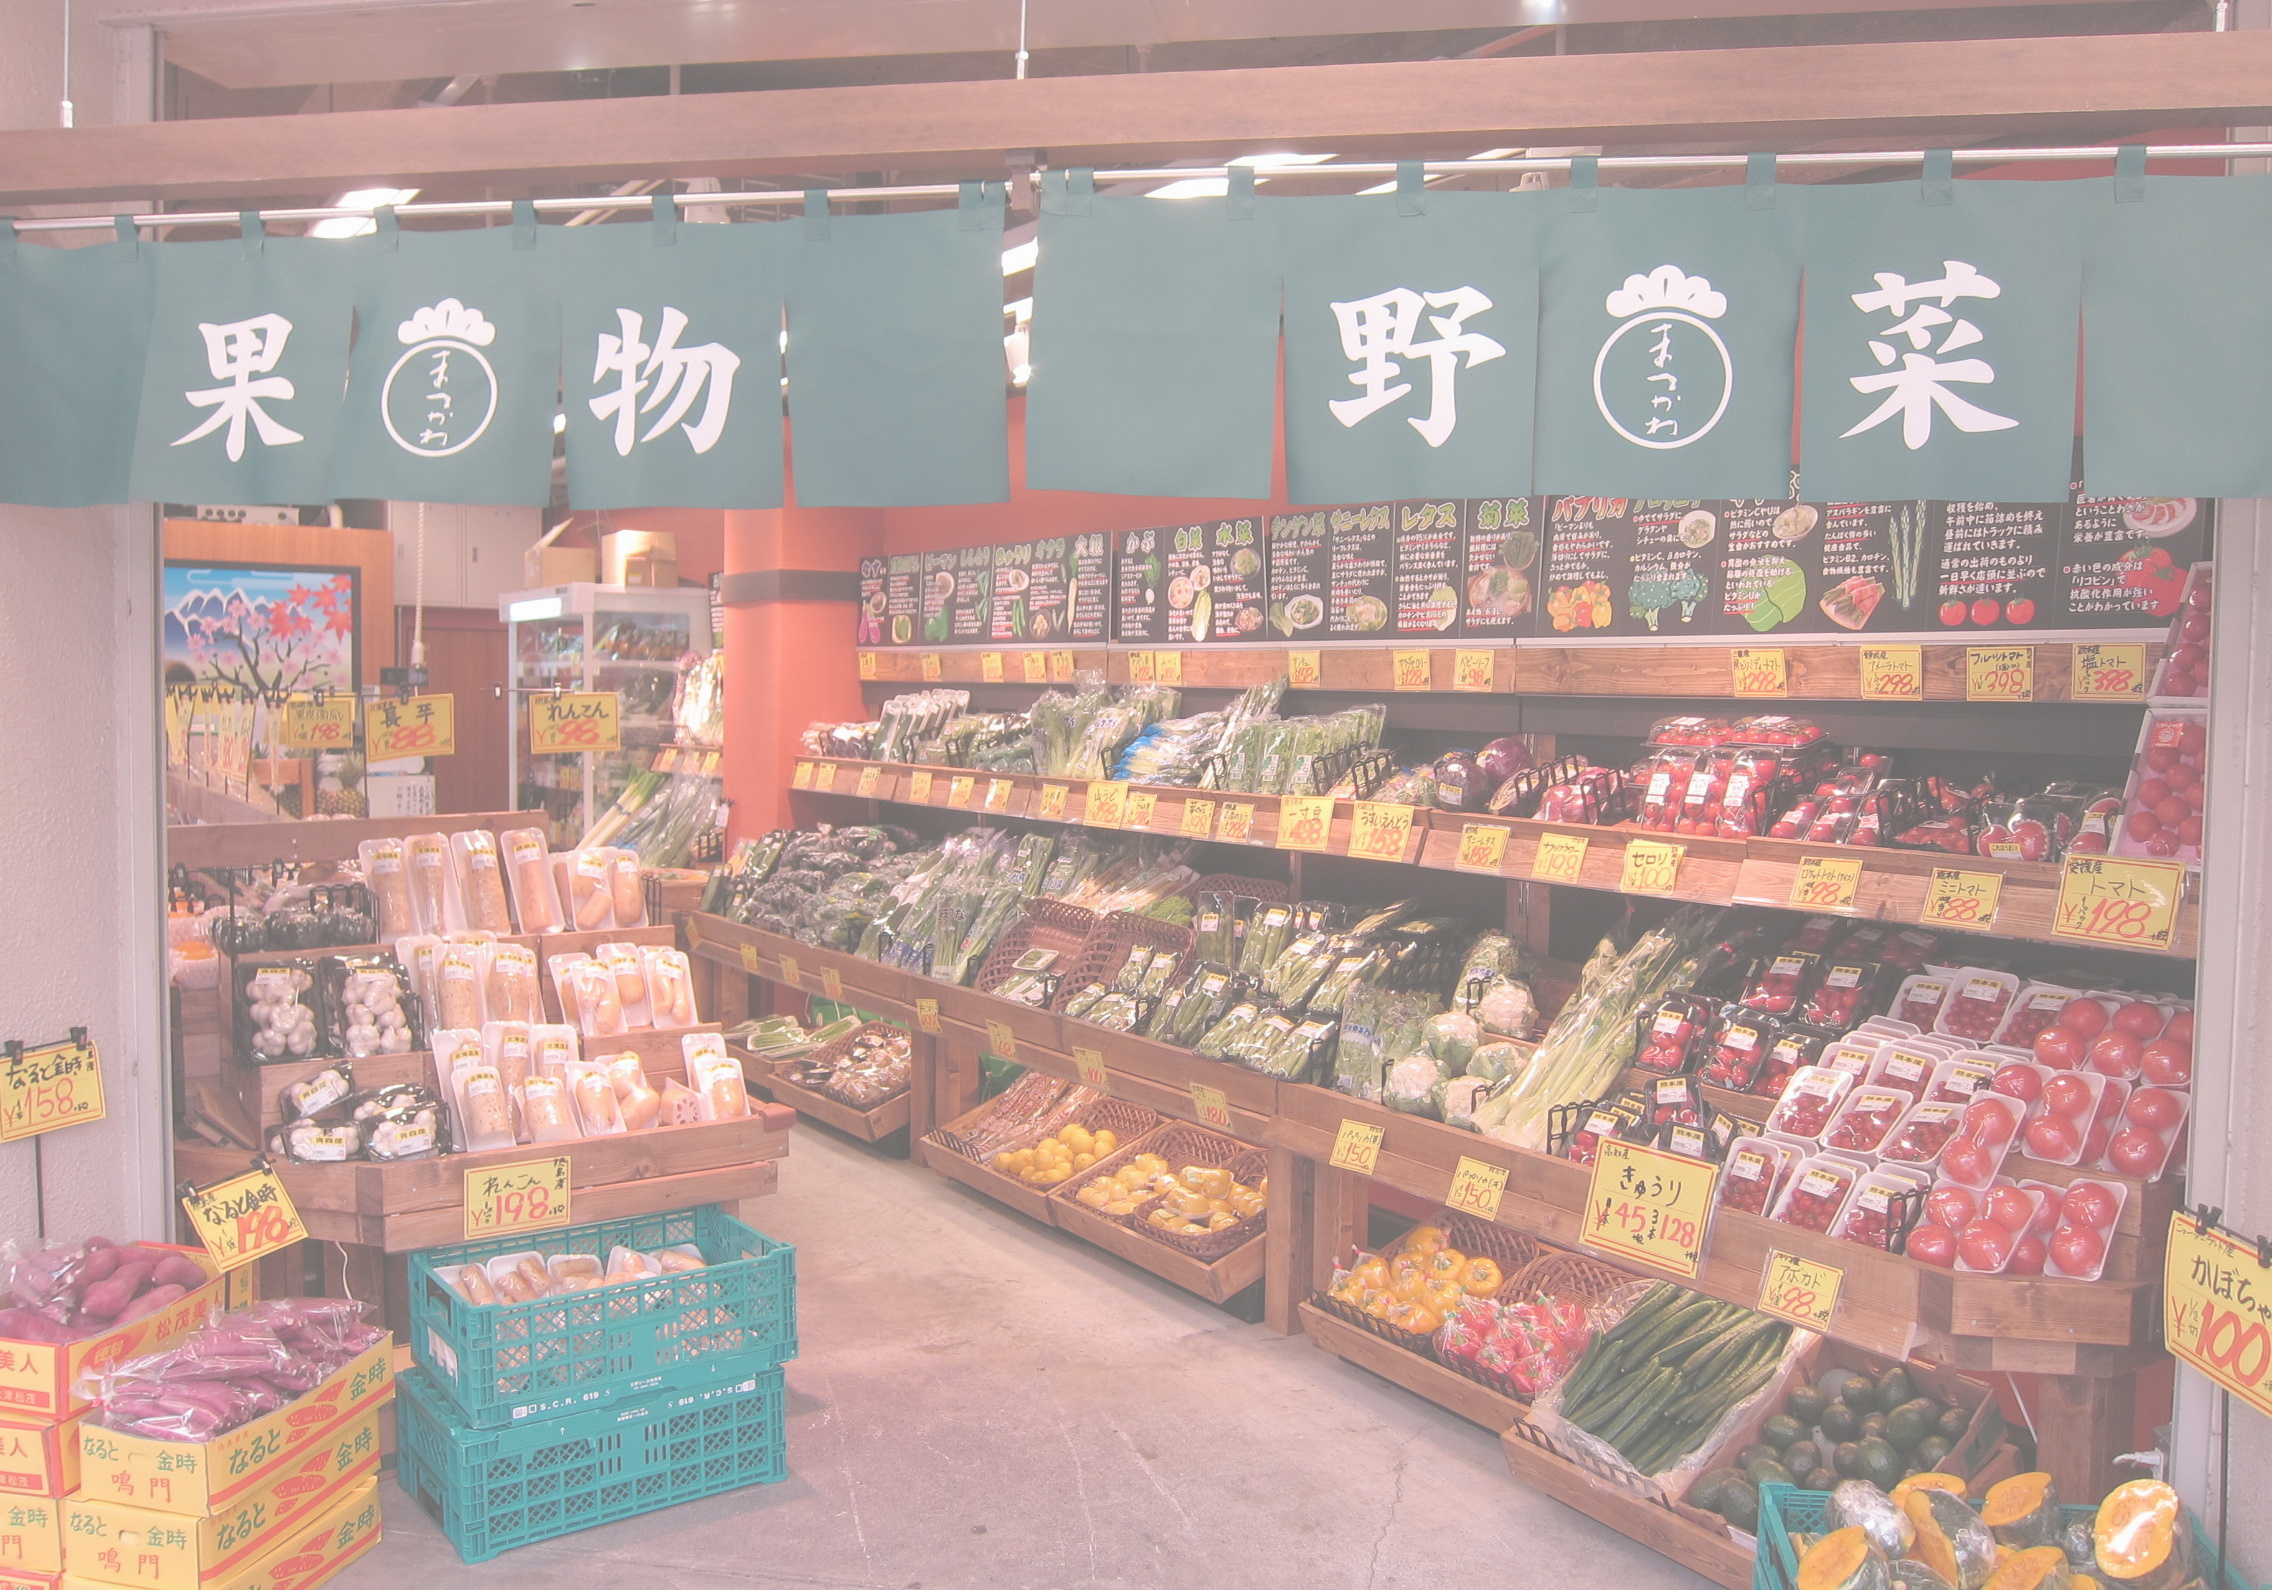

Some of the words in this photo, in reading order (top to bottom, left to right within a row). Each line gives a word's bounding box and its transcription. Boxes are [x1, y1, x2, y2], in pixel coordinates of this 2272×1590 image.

[1328, 285, 1507, 448] 野
[1838, 259, 2020, 451] 菜
[170, 312, 304, 462] 果
[588, 305, 741, 457] 物
[1645, 322, 1680, 437] まつかわ
[418, 349, 454, 447] まつかわ
[1330, 505, 1391, 534] サニーレタス
[1402, 502, 1457, 531] レタス
[1478, 497, 1530, 530] 菊菜
[1551, 495, 1628, 522] パプリカ
[1945, 510, 2044, 527] 午前中に箱詰めを終え
[1216, 519, 1254, 547] 水菜
[1637, 525, 1668, 534] グラタンや
[1729, 530, 1769, 540] サラダなどの
[1944, 524, 2043, 541] 昼前にはトラックに積み
[2074, 517, 2116, 530] あるように
[1126, 530, 1155, 553] かぶ
[1174, 525, 1203, 552] 白菜
[1943, 539, 2021, 553] 運ばれていきます。
[2073, 530, 2149, 543] 栄養が豊富です。
[1940, 554, 2033, 570] 通常の出荷のものより
[2072, 561, 2143, 573] 赤い色の成分は
[1939, 567, 2046, 582] 一日早く店頭に並ぶので
[1938, 582, 2017, 596] 新鮮さが違います。
[2070, 587, 2153, 600] 抗酸化作用が強い
[1869, 661, 1913, 672] アメーラトマト
[2081, 655, 2127, 669] 塩トマト
[1747, 672, 1777, 692] 298
[1878, 673, 1913, 695] 298
[1985, 669, 2025, 694] 398
[2093, 669, 2135, 693] 398
[546, 702, 609, 722] れんこん
[310, 723, 341, 741] 198
[390, 724, 438, 750] 88
[559, 719, 600, 746] 98
[1289, 805, 1322, 821] 一寸豆
[1360, 811, 1409, 830] うすいえんどう
[1367, 827, 1404, 855] 158
[1467, 835, 1496, 846] サニーレタス
[1469, 846, 1491, 866] 158
[1546, 854, 1579, 876] 198
[1632, 851, 1668, 867] セロリ
[1638, 867, 1672, 890] 100
[1938, 881, 1987, 896] ミニトマト
[2090, 875, 2145, 899] トマト
[1810, 881, 1841, 905] 98
[1942, 898, 1981, 921] 88
[2085, 898, 2152, 939] 198
[1971, 978, 2000, 988] 熊本産
[1842, 1052, 1868, 1062] 熊本産
[1895, 1053, 1923, 1066] 熊本産
[5, 1053, 83, 1090] なると金時
[1660, 1080, 1685, 1088] 熊本産
[24, 1077, 74, 1126] 158
[315, 1137, 343, 1145] 青森産
[399, 1128, 428, 1140] 青森産
[1677, 1128, 1701, 1140] 熊本産
[1343, 1141, 1372, 1165] 150
[1603, 1144, 1630, 1160] 高知産
[1740, 1154, 1762, 1166] 熊本産
[482, 1173, 542, 1198] れんこん
[1620, 1165, 1682, 1207] きゅうり
[1811, 1170, 1838, 1183] 熊本産
[202, 1182, 279, 1226] なると金時
[495, 1186, 550, 1226] 198
[1460, 1181, 1492, 1209] 150
[236, 1205, 290, 1254] 198
[1614, 1202, 1647, 1233] 45
[1659, 1214, 1697, 1249] 128
[1779, 1264, 1827, 1290] アボカド
[1783, 1286, 1817, 1318] 98
[2191, 1254, 2272, 1326] かぼちゃ
[2195, 1299, 2271, 1388] 100
[349, 1357, 387, 1401] 金時
[540, 1399, 578, 1411] S.C.R.
[583, 1391, 600, 1401] 619
[678, 1396, 695, 1407] 619
[84, 1436, 120, 1462] なると
[229, 1428, 281, 1476] なると
[334, 1426, 373, 1472] 金時
[155, 1449, 197, 1475] 金時
[111, 1470, 172, 1504] 鳴門
[8, 1505, 48, 1529] 金時
[70, 1512, 108, 1537] なると
[216, 1502, 266, 1551] なると
[336, 1503, 376, 1550] 金時
[1, 1534, 23, 1560] 門
[147, 1525, 188, 1550] 金時
[98, 1547, 159, 1580] 鳴門
